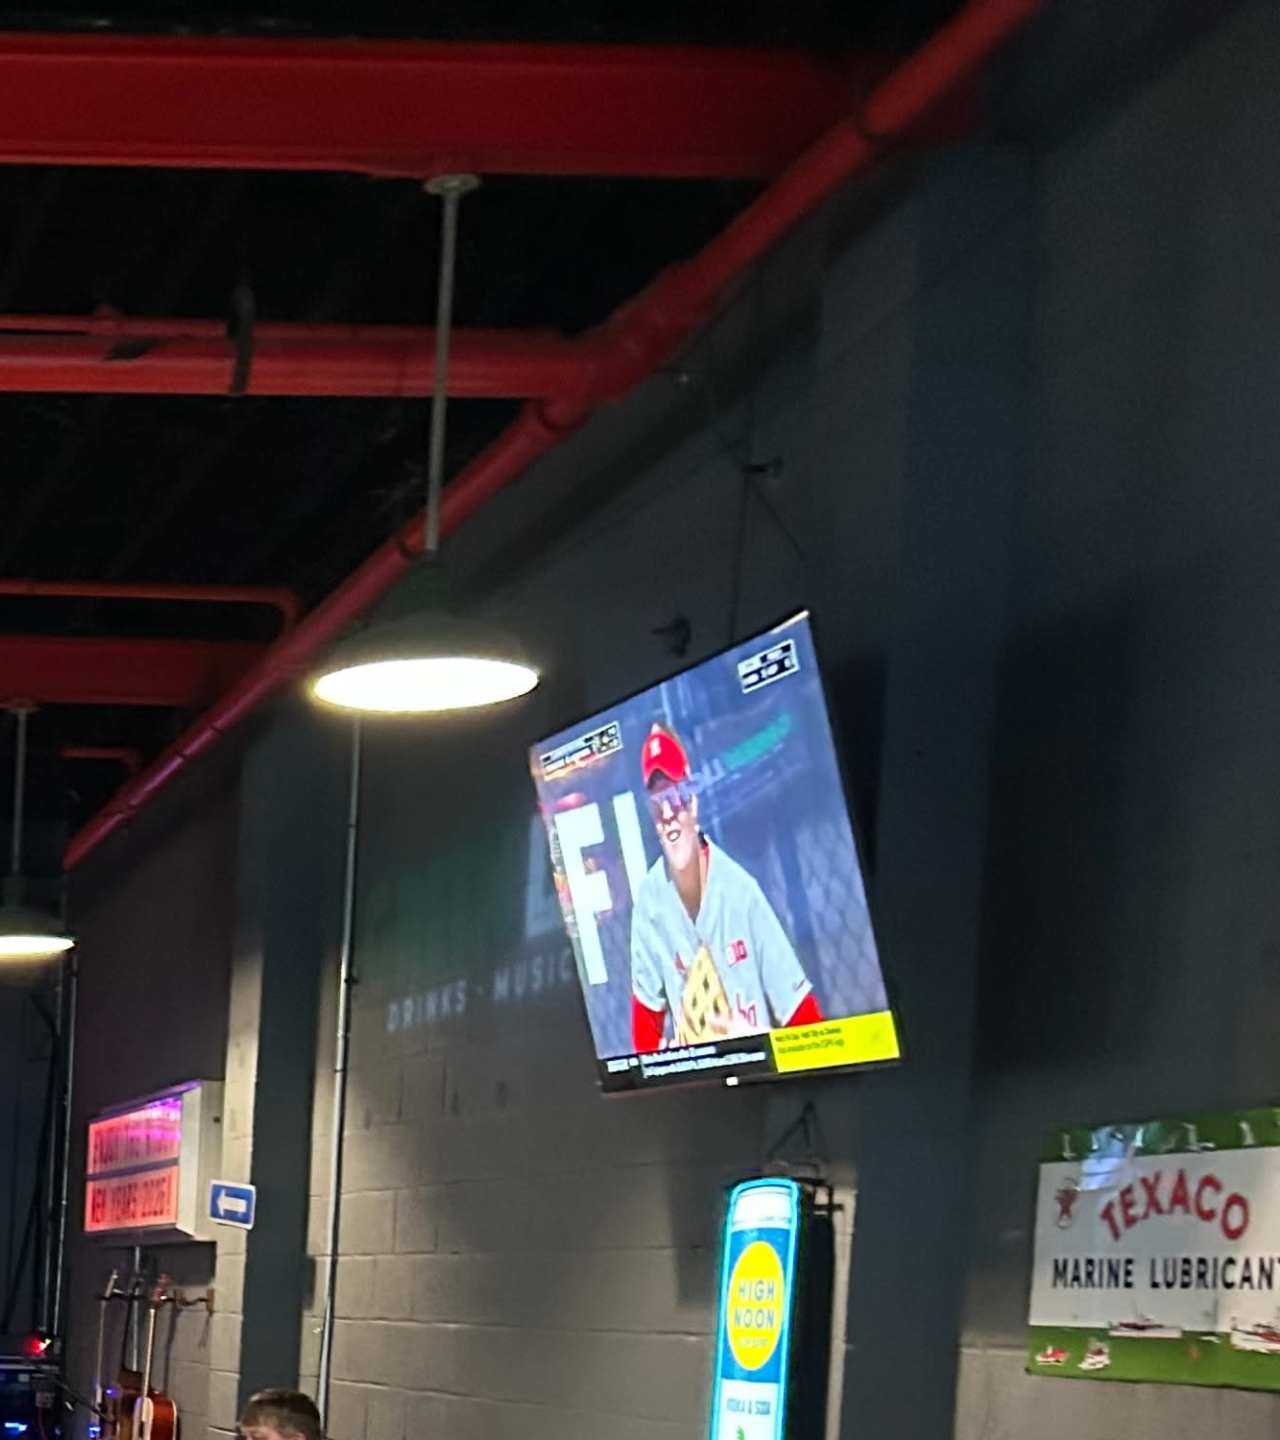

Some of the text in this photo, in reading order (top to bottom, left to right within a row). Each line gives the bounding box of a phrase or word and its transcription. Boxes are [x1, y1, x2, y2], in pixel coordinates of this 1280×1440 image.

[1100, 1168, 1249, 1241] TEXACO
[1052, 1257, 1280, 1290] MARINE LUBRICAN
[738, 1280, 774, 1301] HIGH
[734, 1308, 774, 1329] NOON
